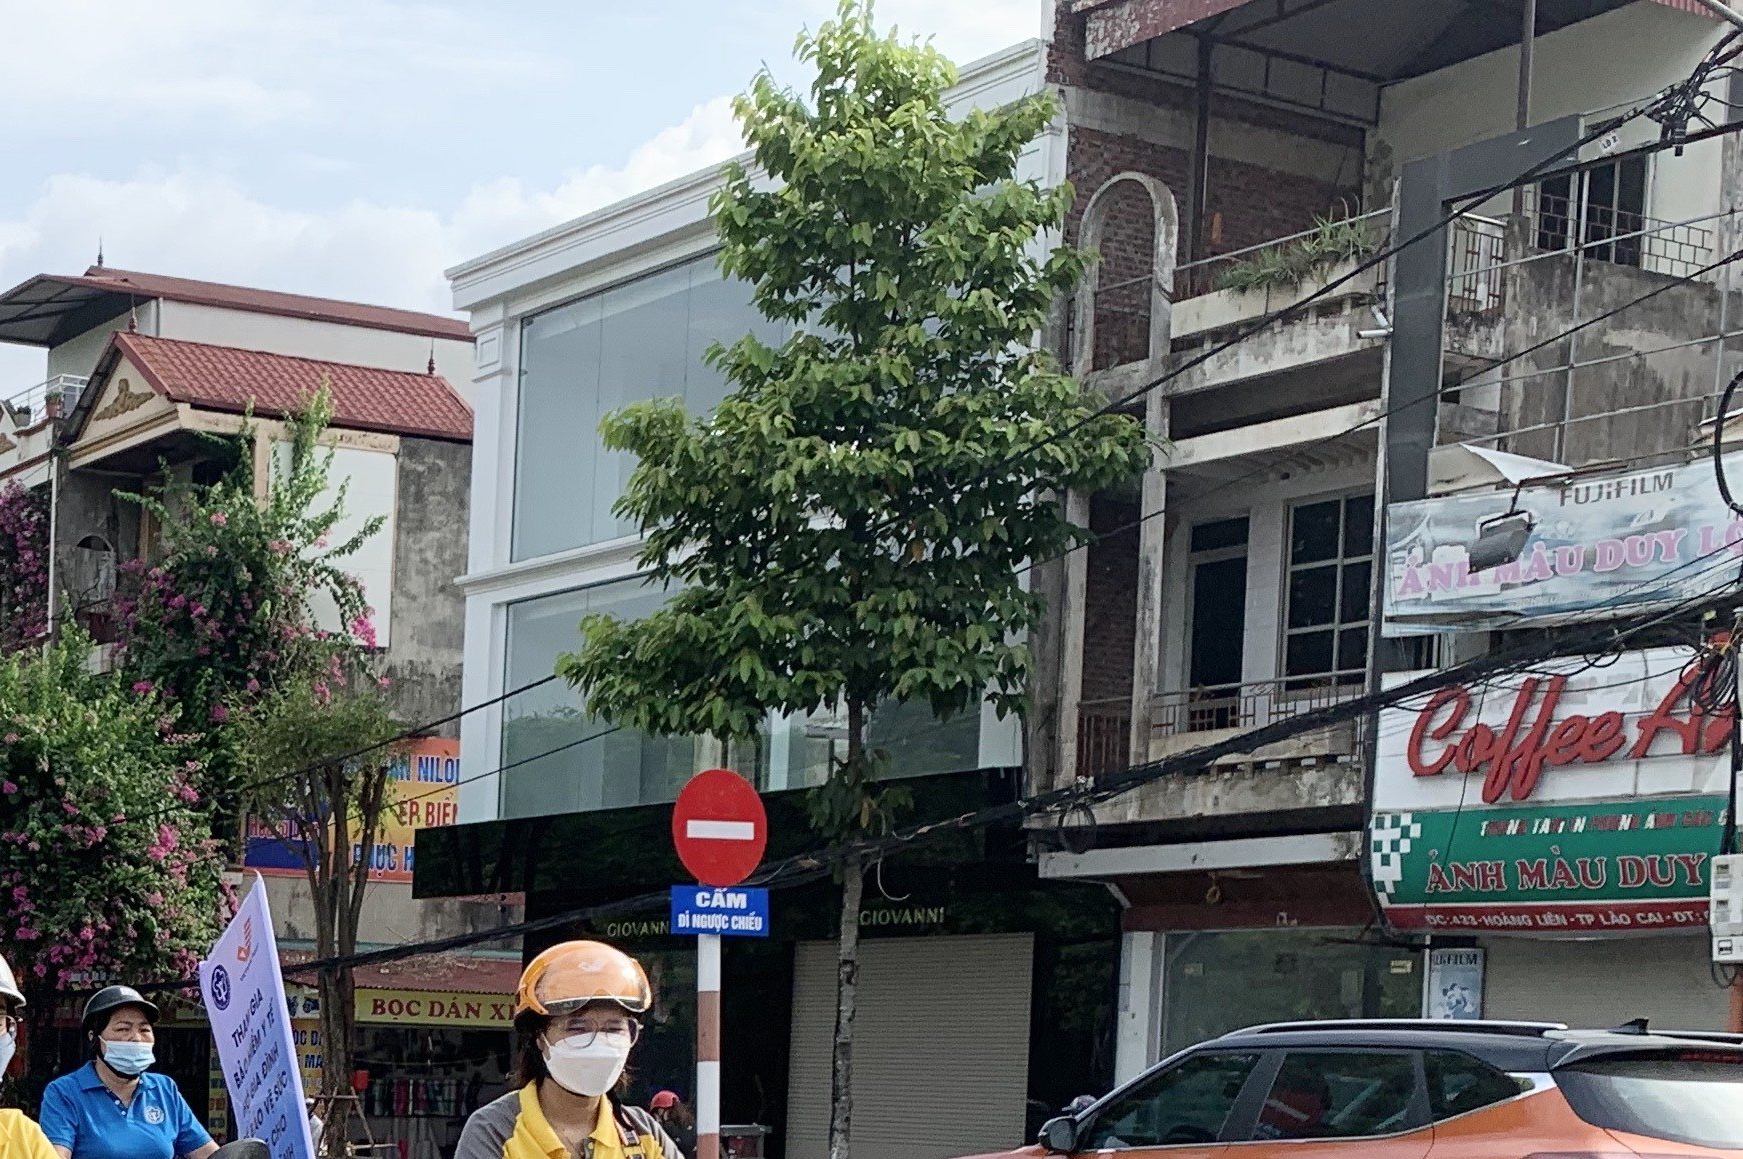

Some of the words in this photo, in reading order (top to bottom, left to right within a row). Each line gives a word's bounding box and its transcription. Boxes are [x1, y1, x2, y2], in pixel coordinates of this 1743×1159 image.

[1594, 528, 1686, 573] DUY
[1407, 674, 1625, 803] Coffee
[1425, 849, 1507, 894] ẢNH
[1517, 844, 1607, 890] MÀU
[1618, 853, 1707, 888] DUY
[695, 887, 747, 909] CẤM
[692, 913, 729, 932] NGƯỢC
[860, 907, 945, 926] GIOVANNI
[249, 988, 263, 1016] GIA
[372, 998, 420, 1019] BỌC
[428, 997, 480, 1019] DÁN
[270, 1114, 287, 1146] CHO
